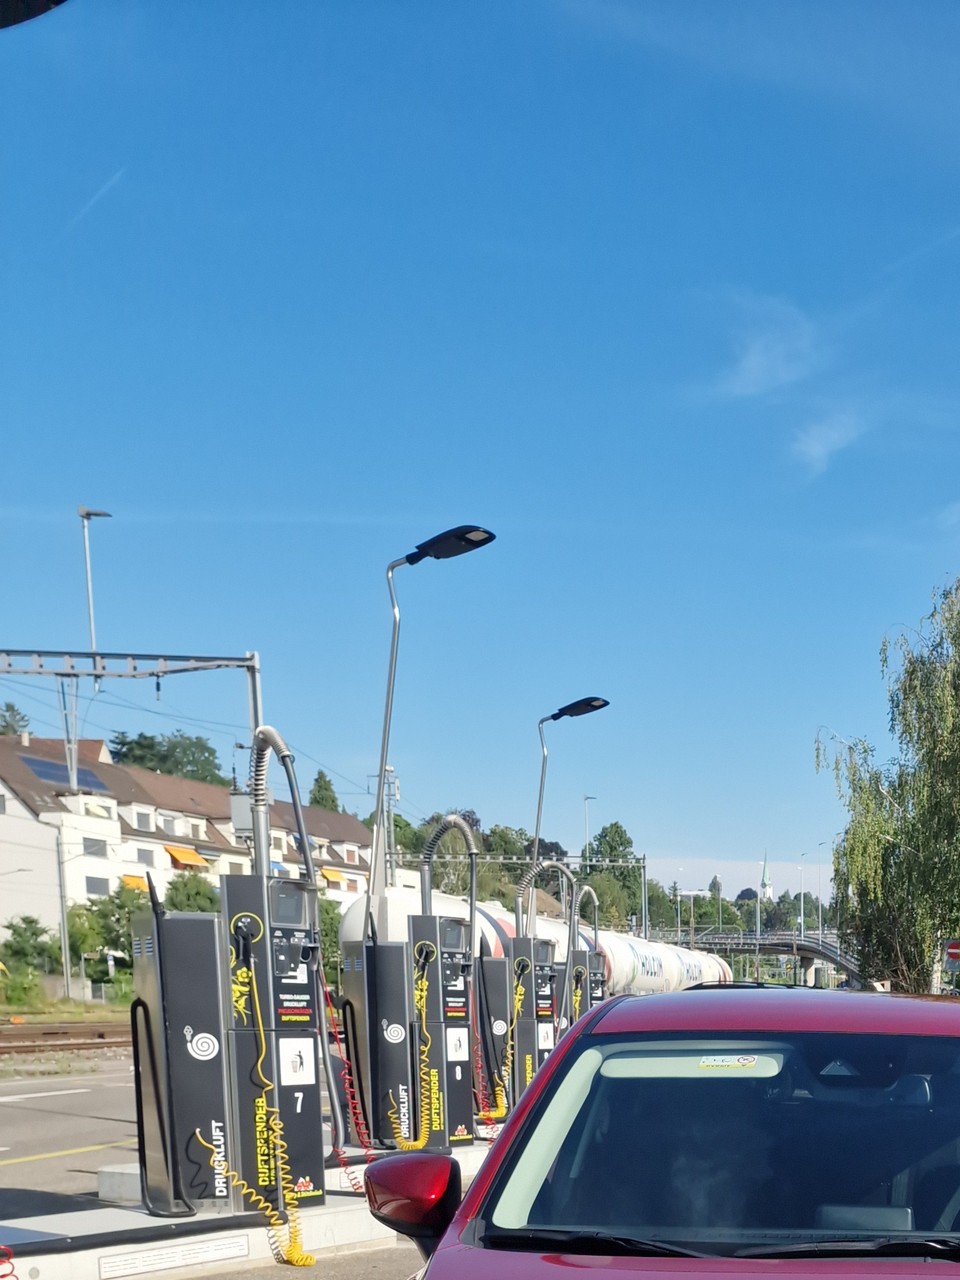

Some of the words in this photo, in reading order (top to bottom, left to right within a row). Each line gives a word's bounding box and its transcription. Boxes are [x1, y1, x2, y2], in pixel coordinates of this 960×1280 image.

[294, 1092, 304, 1113] 7
[398, 1083, 410, 1138] DRUCKLUFT
[430, 1068, 441, 1131] DUFTSPENDER
[212, 1120, 227, 1196] DRUCKLUFT
[255, 1097, 270, 1186] DUFTSPENDER
